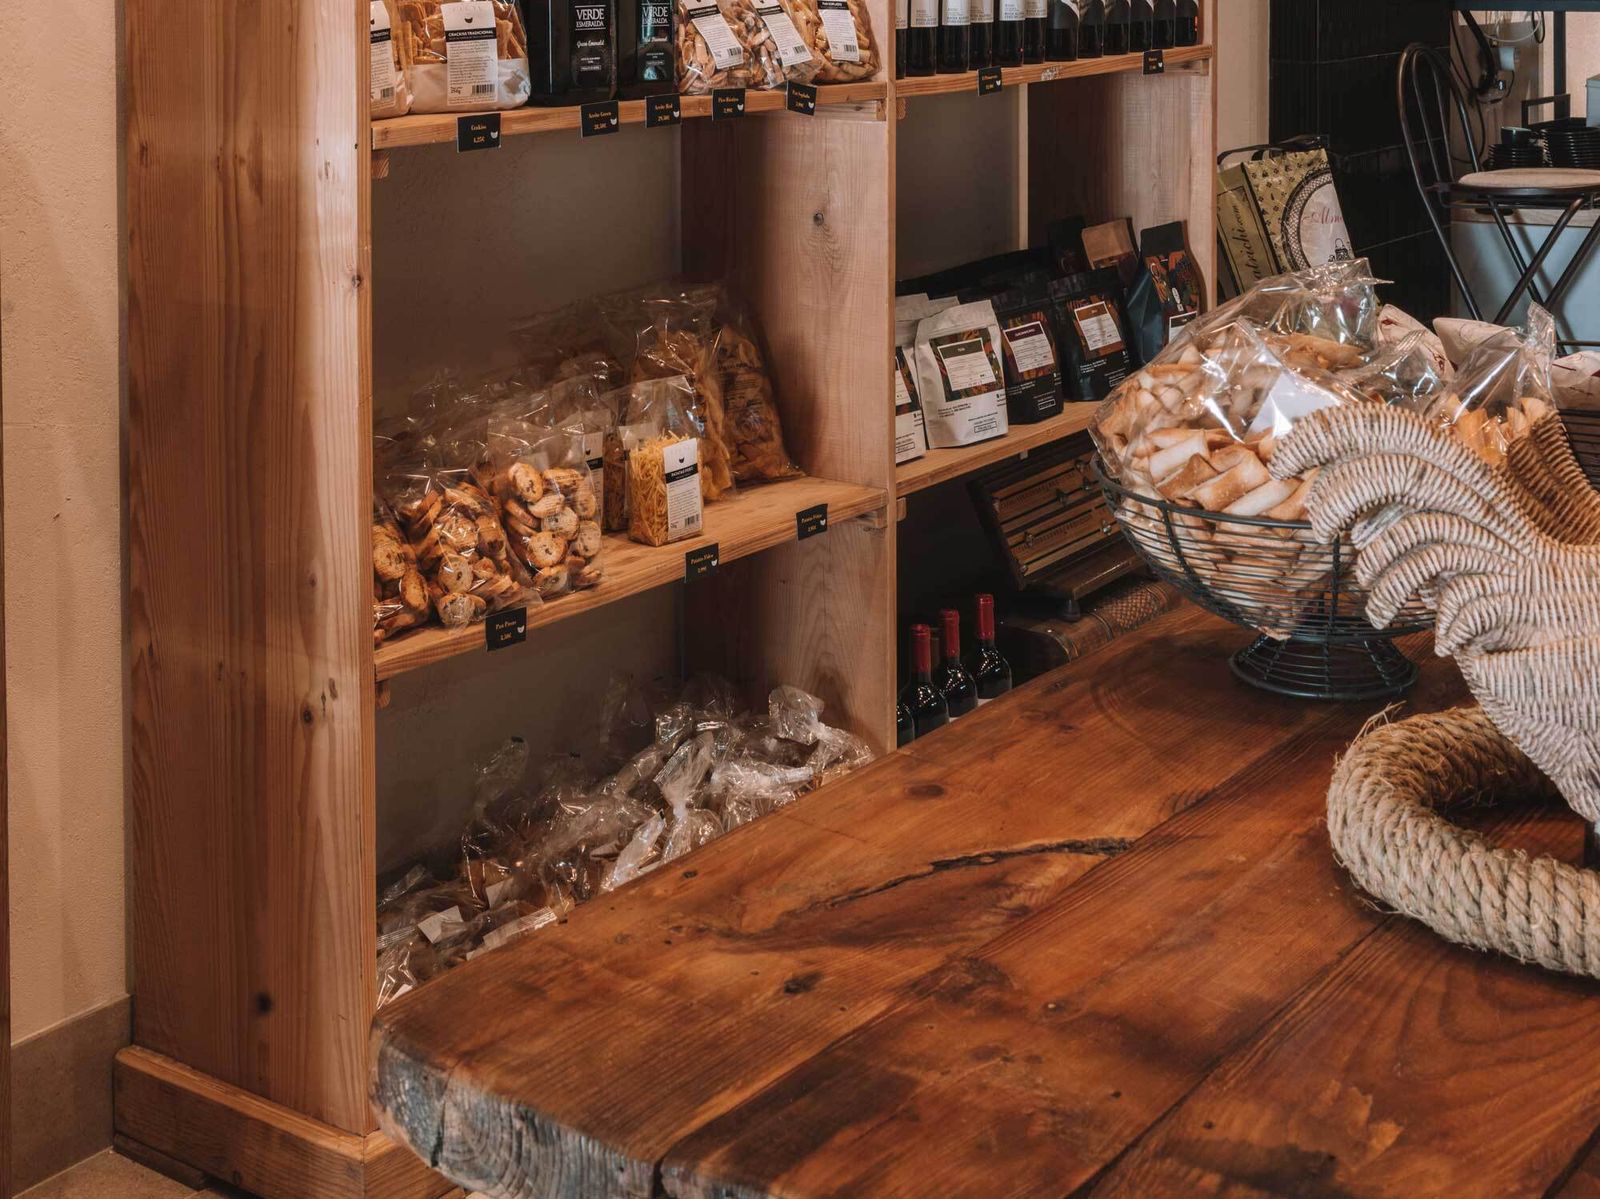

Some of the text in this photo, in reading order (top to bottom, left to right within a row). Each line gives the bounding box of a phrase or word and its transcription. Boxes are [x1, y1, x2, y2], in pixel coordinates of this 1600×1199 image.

[576, 8, 605, 20] VERDE
[643, 6, 669, 17] VERDE
[576, 20, 605, 28] ESMERALDA
